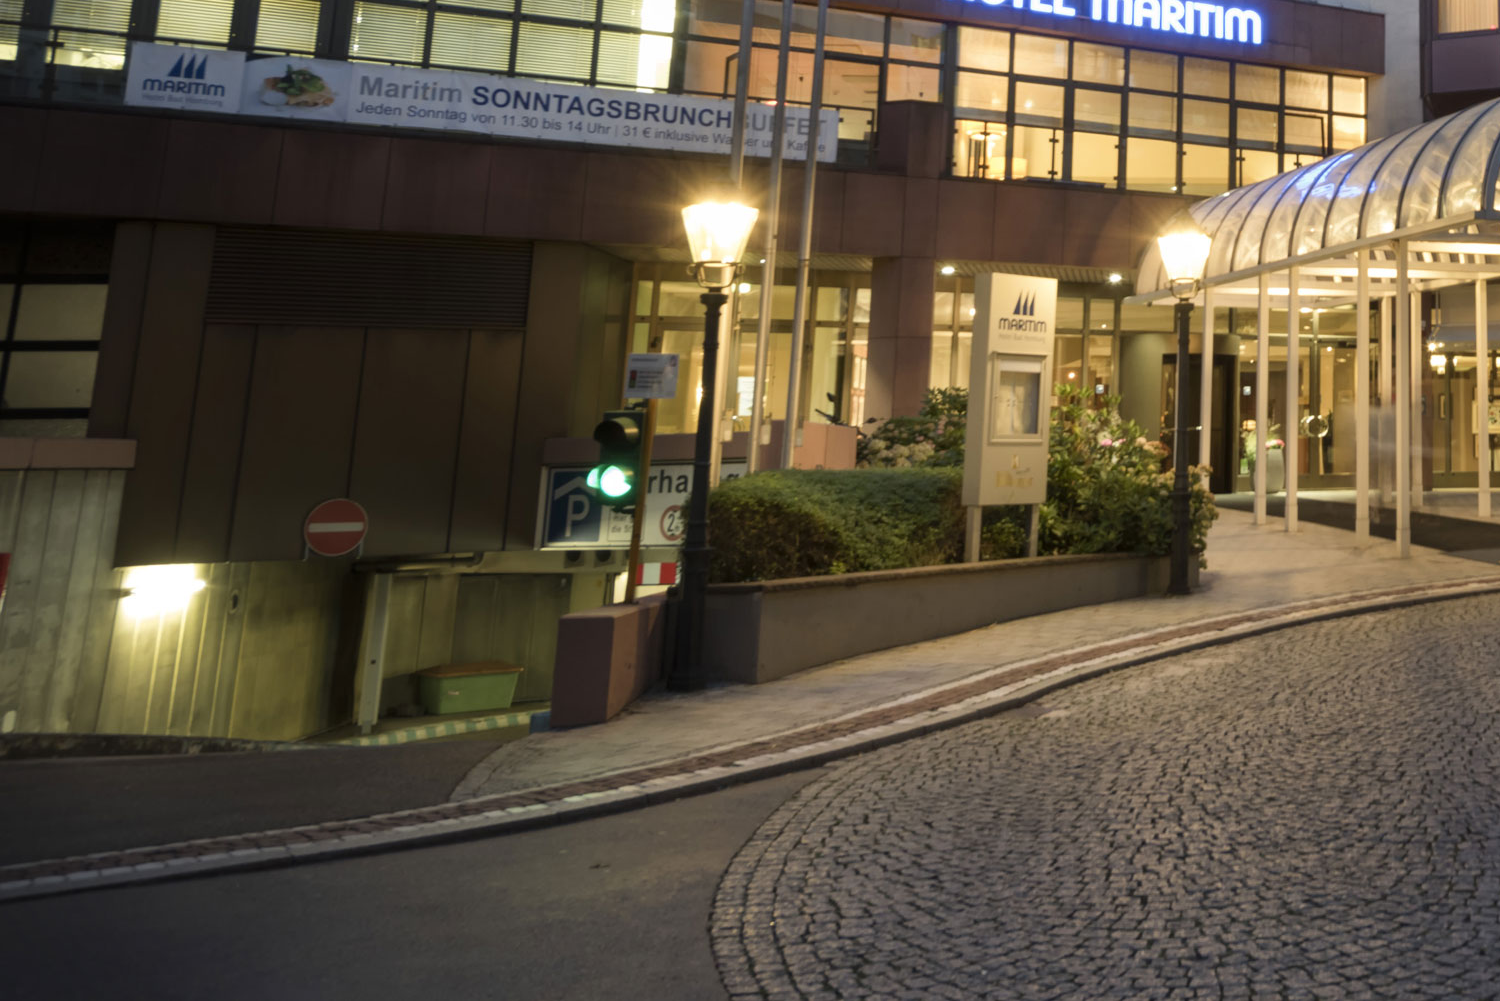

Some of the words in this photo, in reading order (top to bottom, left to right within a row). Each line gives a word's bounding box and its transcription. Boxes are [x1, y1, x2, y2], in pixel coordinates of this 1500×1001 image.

[142, 78, 226, 97] MARITIM
[359, 75, 463, 103] Maritim
[472, 86, 827, 136] SONNTAGSBRUNCHUFET
[355, 102, 402, 117] Jeden
[406, 105, 467, 123] Sonntag
[471, 113, 496, 125] von
[502, 114, 538, 130] 11.30
[542, 118, 562, 131] bis
[568, 119, 583, 132] 14
[587, 122, 611, 136] Uhr
[622, 125, 638, 138] 31
[642, 126, 652, 139] €
[654, 129, 709, 144] inklusive
[712, 133, 759, 147] Waer
[786, 138, 827, 153] Kafe
[998, 318, 1048, 333] MARITIM
[564, 494, 591, 538] P
